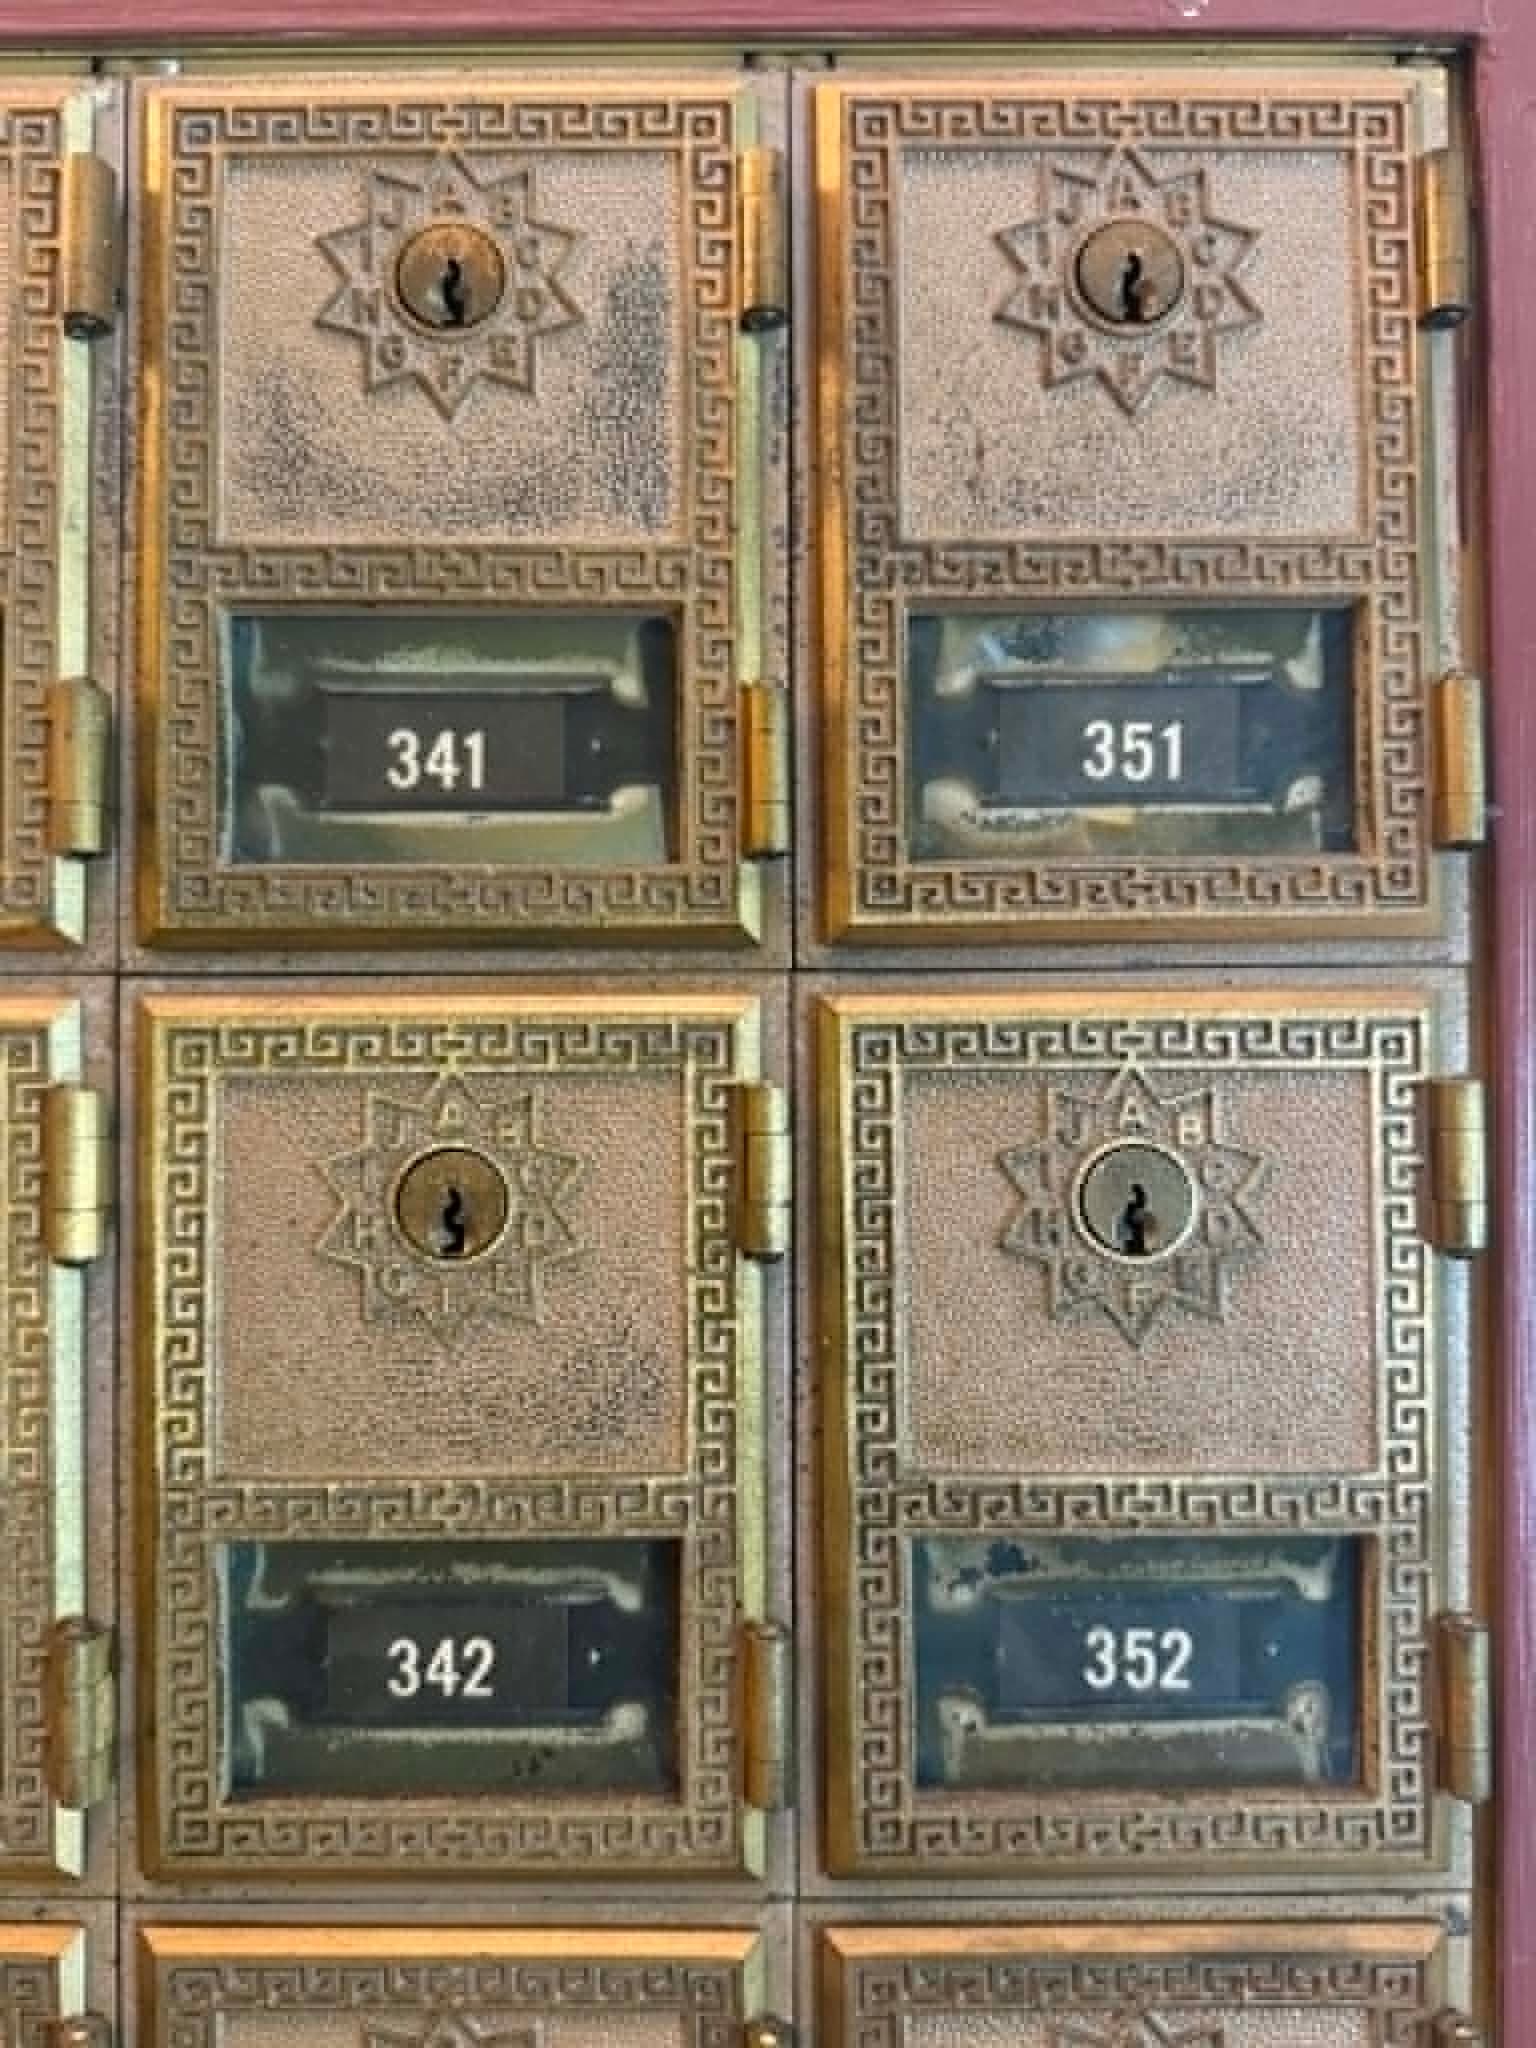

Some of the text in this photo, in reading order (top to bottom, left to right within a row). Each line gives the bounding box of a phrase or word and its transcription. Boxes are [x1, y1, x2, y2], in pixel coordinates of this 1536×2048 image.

[386, 729, 486, 790] 341
[1082, 720, 1184, 782] 351
[386, 1637, 496, 1697] 342
[1083, 1625, 1192, 1690] 352
